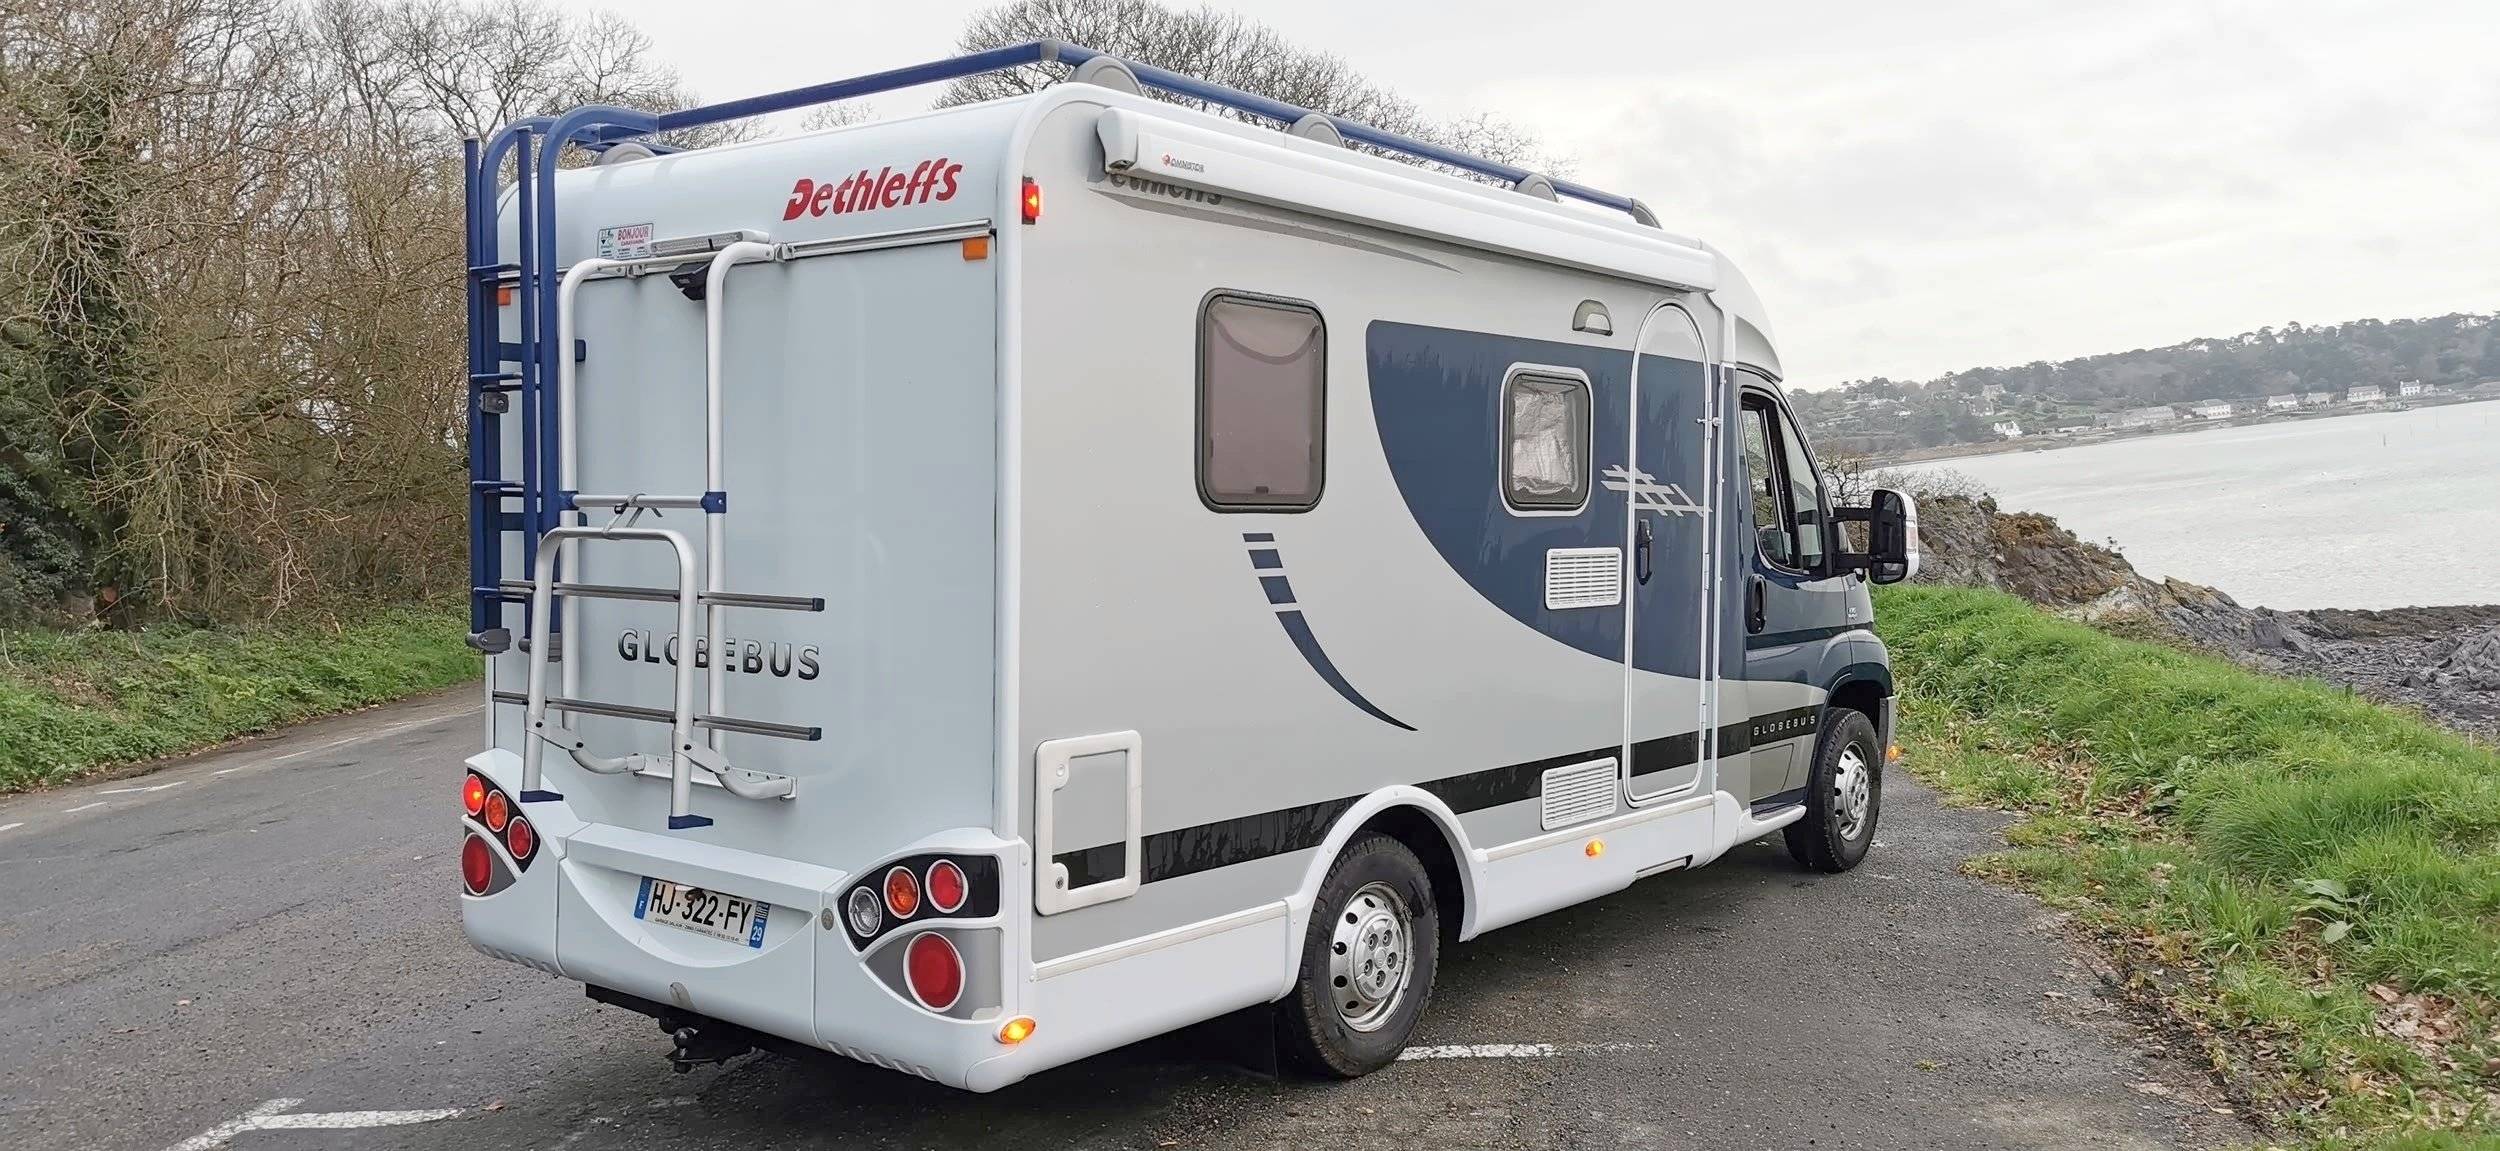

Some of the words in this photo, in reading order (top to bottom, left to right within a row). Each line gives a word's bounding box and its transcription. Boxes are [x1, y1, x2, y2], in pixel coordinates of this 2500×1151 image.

[783, 157, 963, 222] Dethleffs
[617, 226, 649, 241] BONJOUR
[1753, 715, 1816, 736] GLOBEBUS
[650, 882, 752, 933] HJ-322-FY
[751, 925, 763, 942] 29
